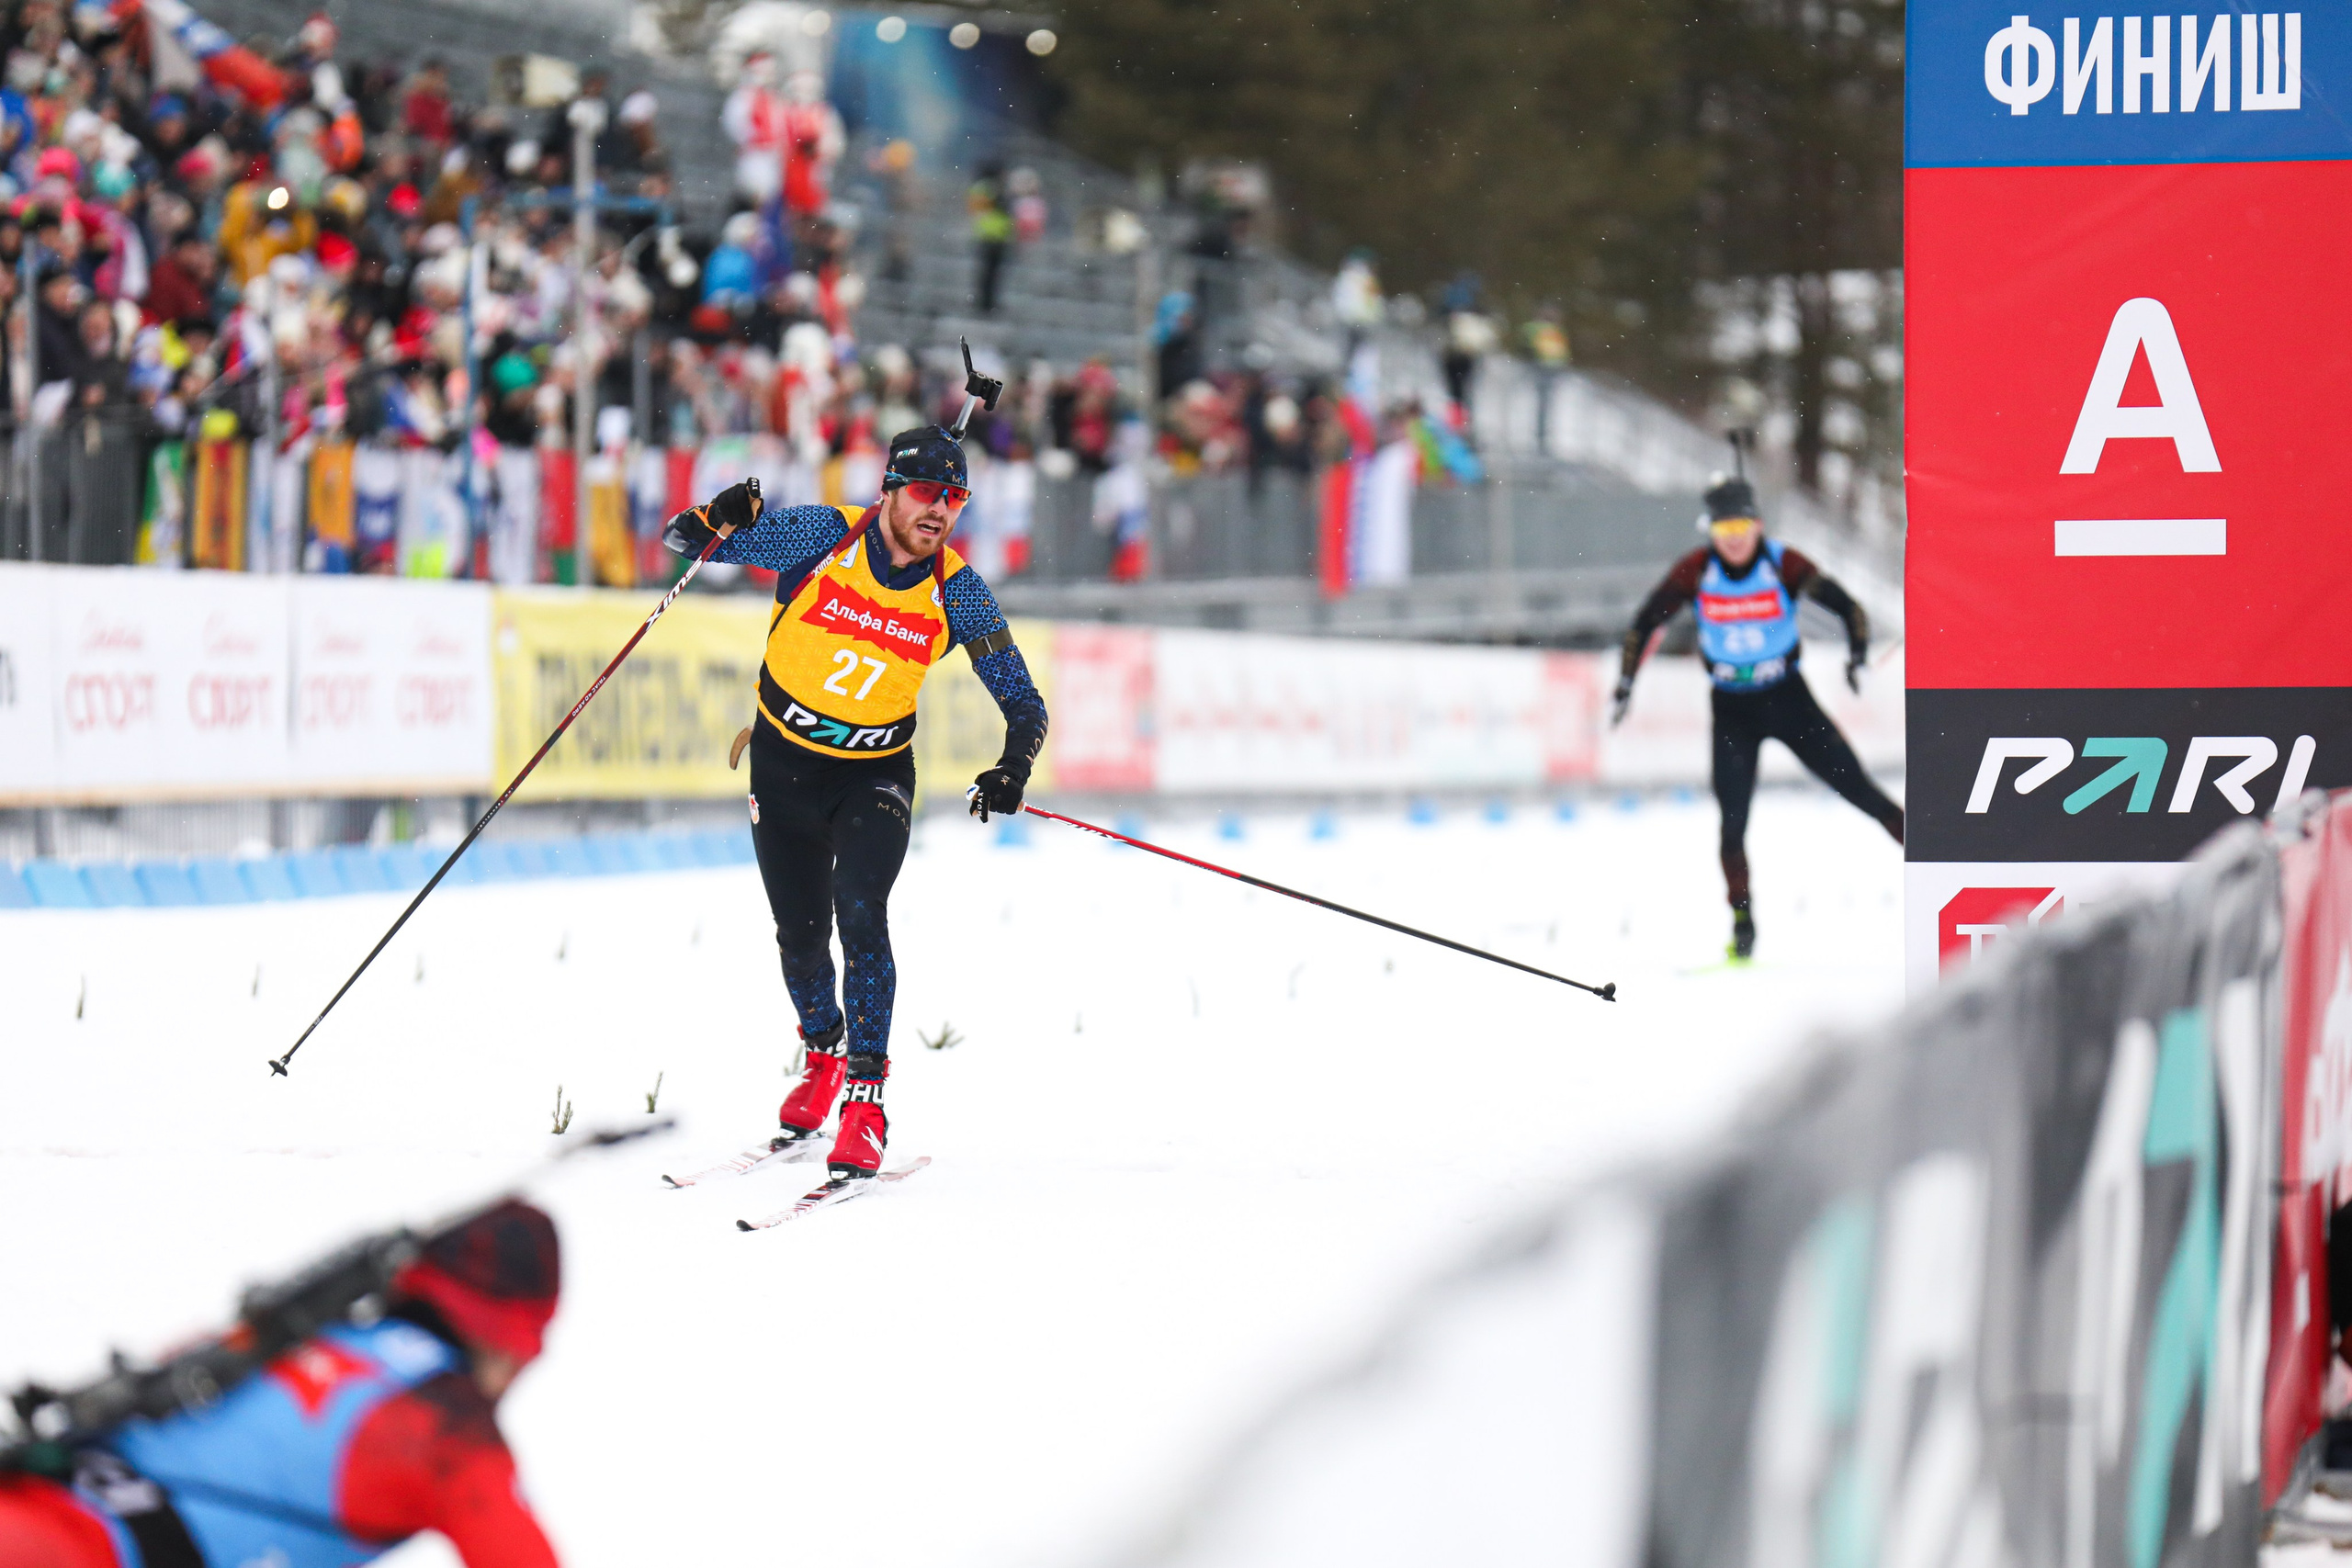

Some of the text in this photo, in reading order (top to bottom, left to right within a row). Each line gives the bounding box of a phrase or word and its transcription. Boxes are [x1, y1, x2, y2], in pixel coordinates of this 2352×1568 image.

[1984, 12, 2302, 116] ФИНИШ
[896, 447, 919, 459] PARI
[822, 597, 930, 647] Альфа Банк
[823, 649, 888, 701] 27
[783, 702, 899, 748] PARI
[1964, 734, 2317, 815] PARI
